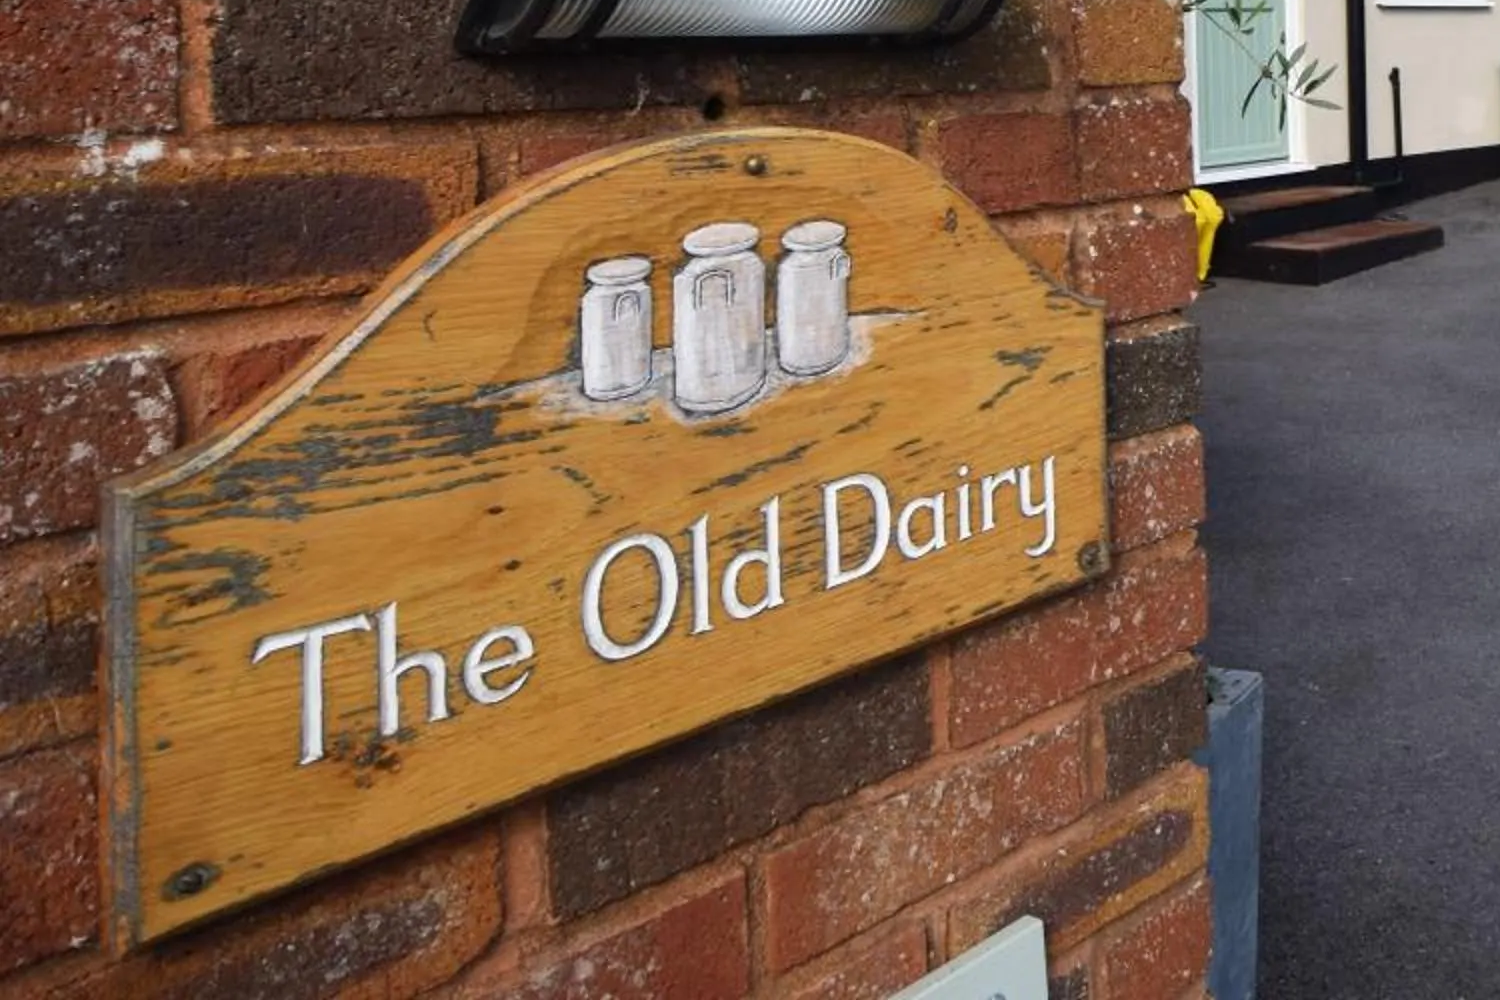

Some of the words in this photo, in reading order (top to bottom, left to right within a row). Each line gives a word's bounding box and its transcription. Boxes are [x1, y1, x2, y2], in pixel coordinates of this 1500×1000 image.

[250, 600, 538, 766] The
[581, 496, 786, 662] Old
[821, 455, 1057, 591] Dairy
